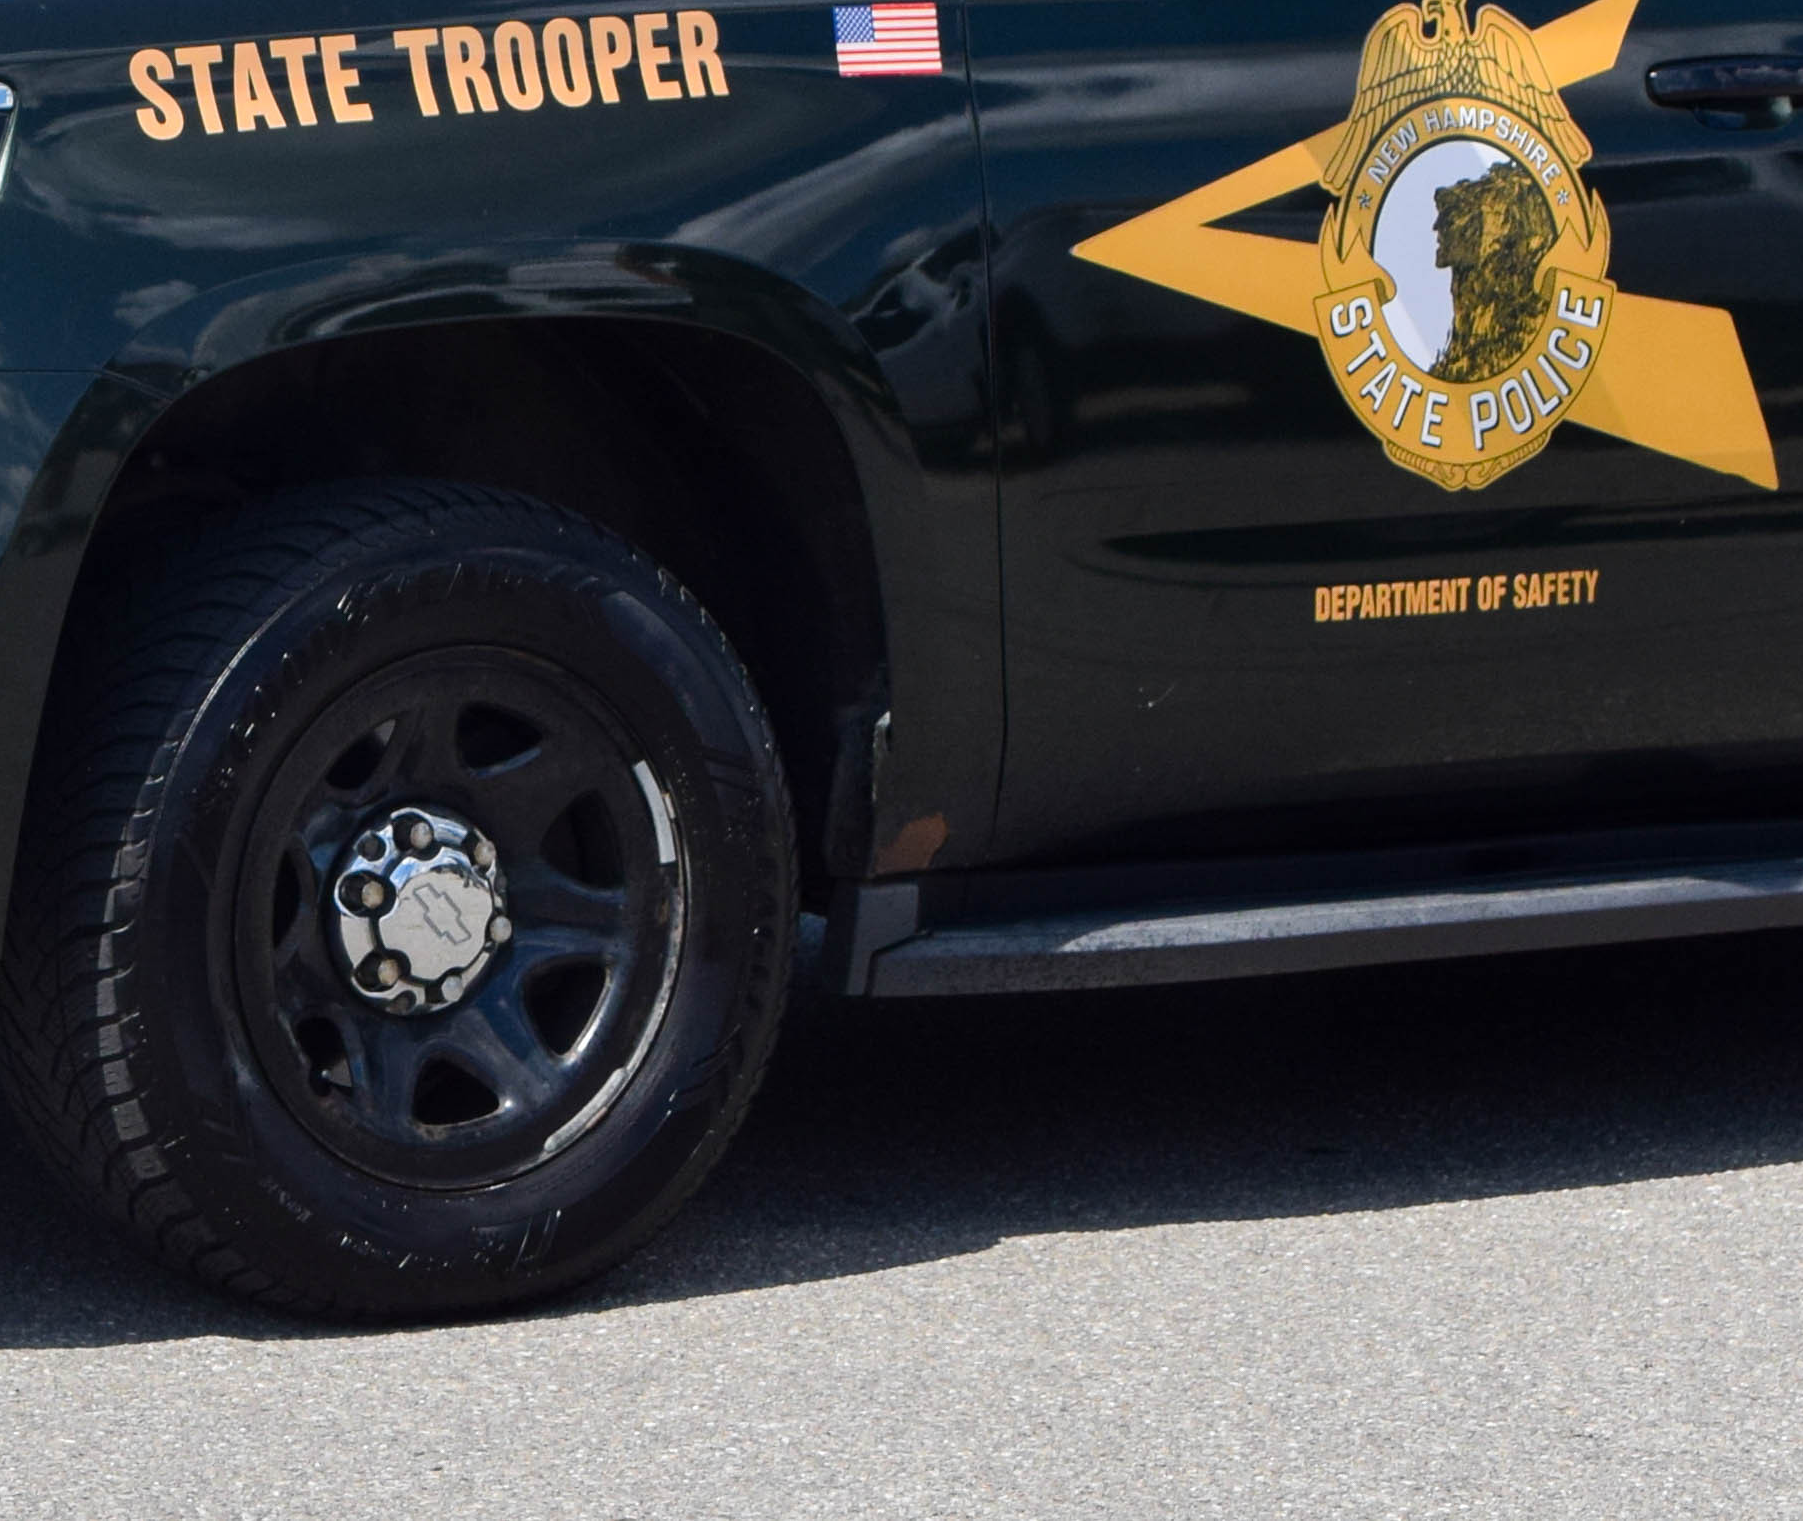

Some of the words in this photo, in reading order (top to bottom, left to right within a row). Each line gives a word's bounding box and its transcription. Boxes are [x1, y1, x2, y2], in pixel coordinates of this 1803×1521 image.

[128, 33, 374, 142] STATE
[393, 10, 730, 117] TROOPER
[1366, 120, 1419, 185] NEW
[1423, 105, 1562, 186] HAMPSHIRE
[1330, 296, 1448, 447] STATE
[1469, 287, 1603, 450] POLICE
[1314, 577, 1471, 622] DEPARTMENT
[1477, 575, 1507, 611] OF
[1513, 569, 1598, 609] SAFETY
